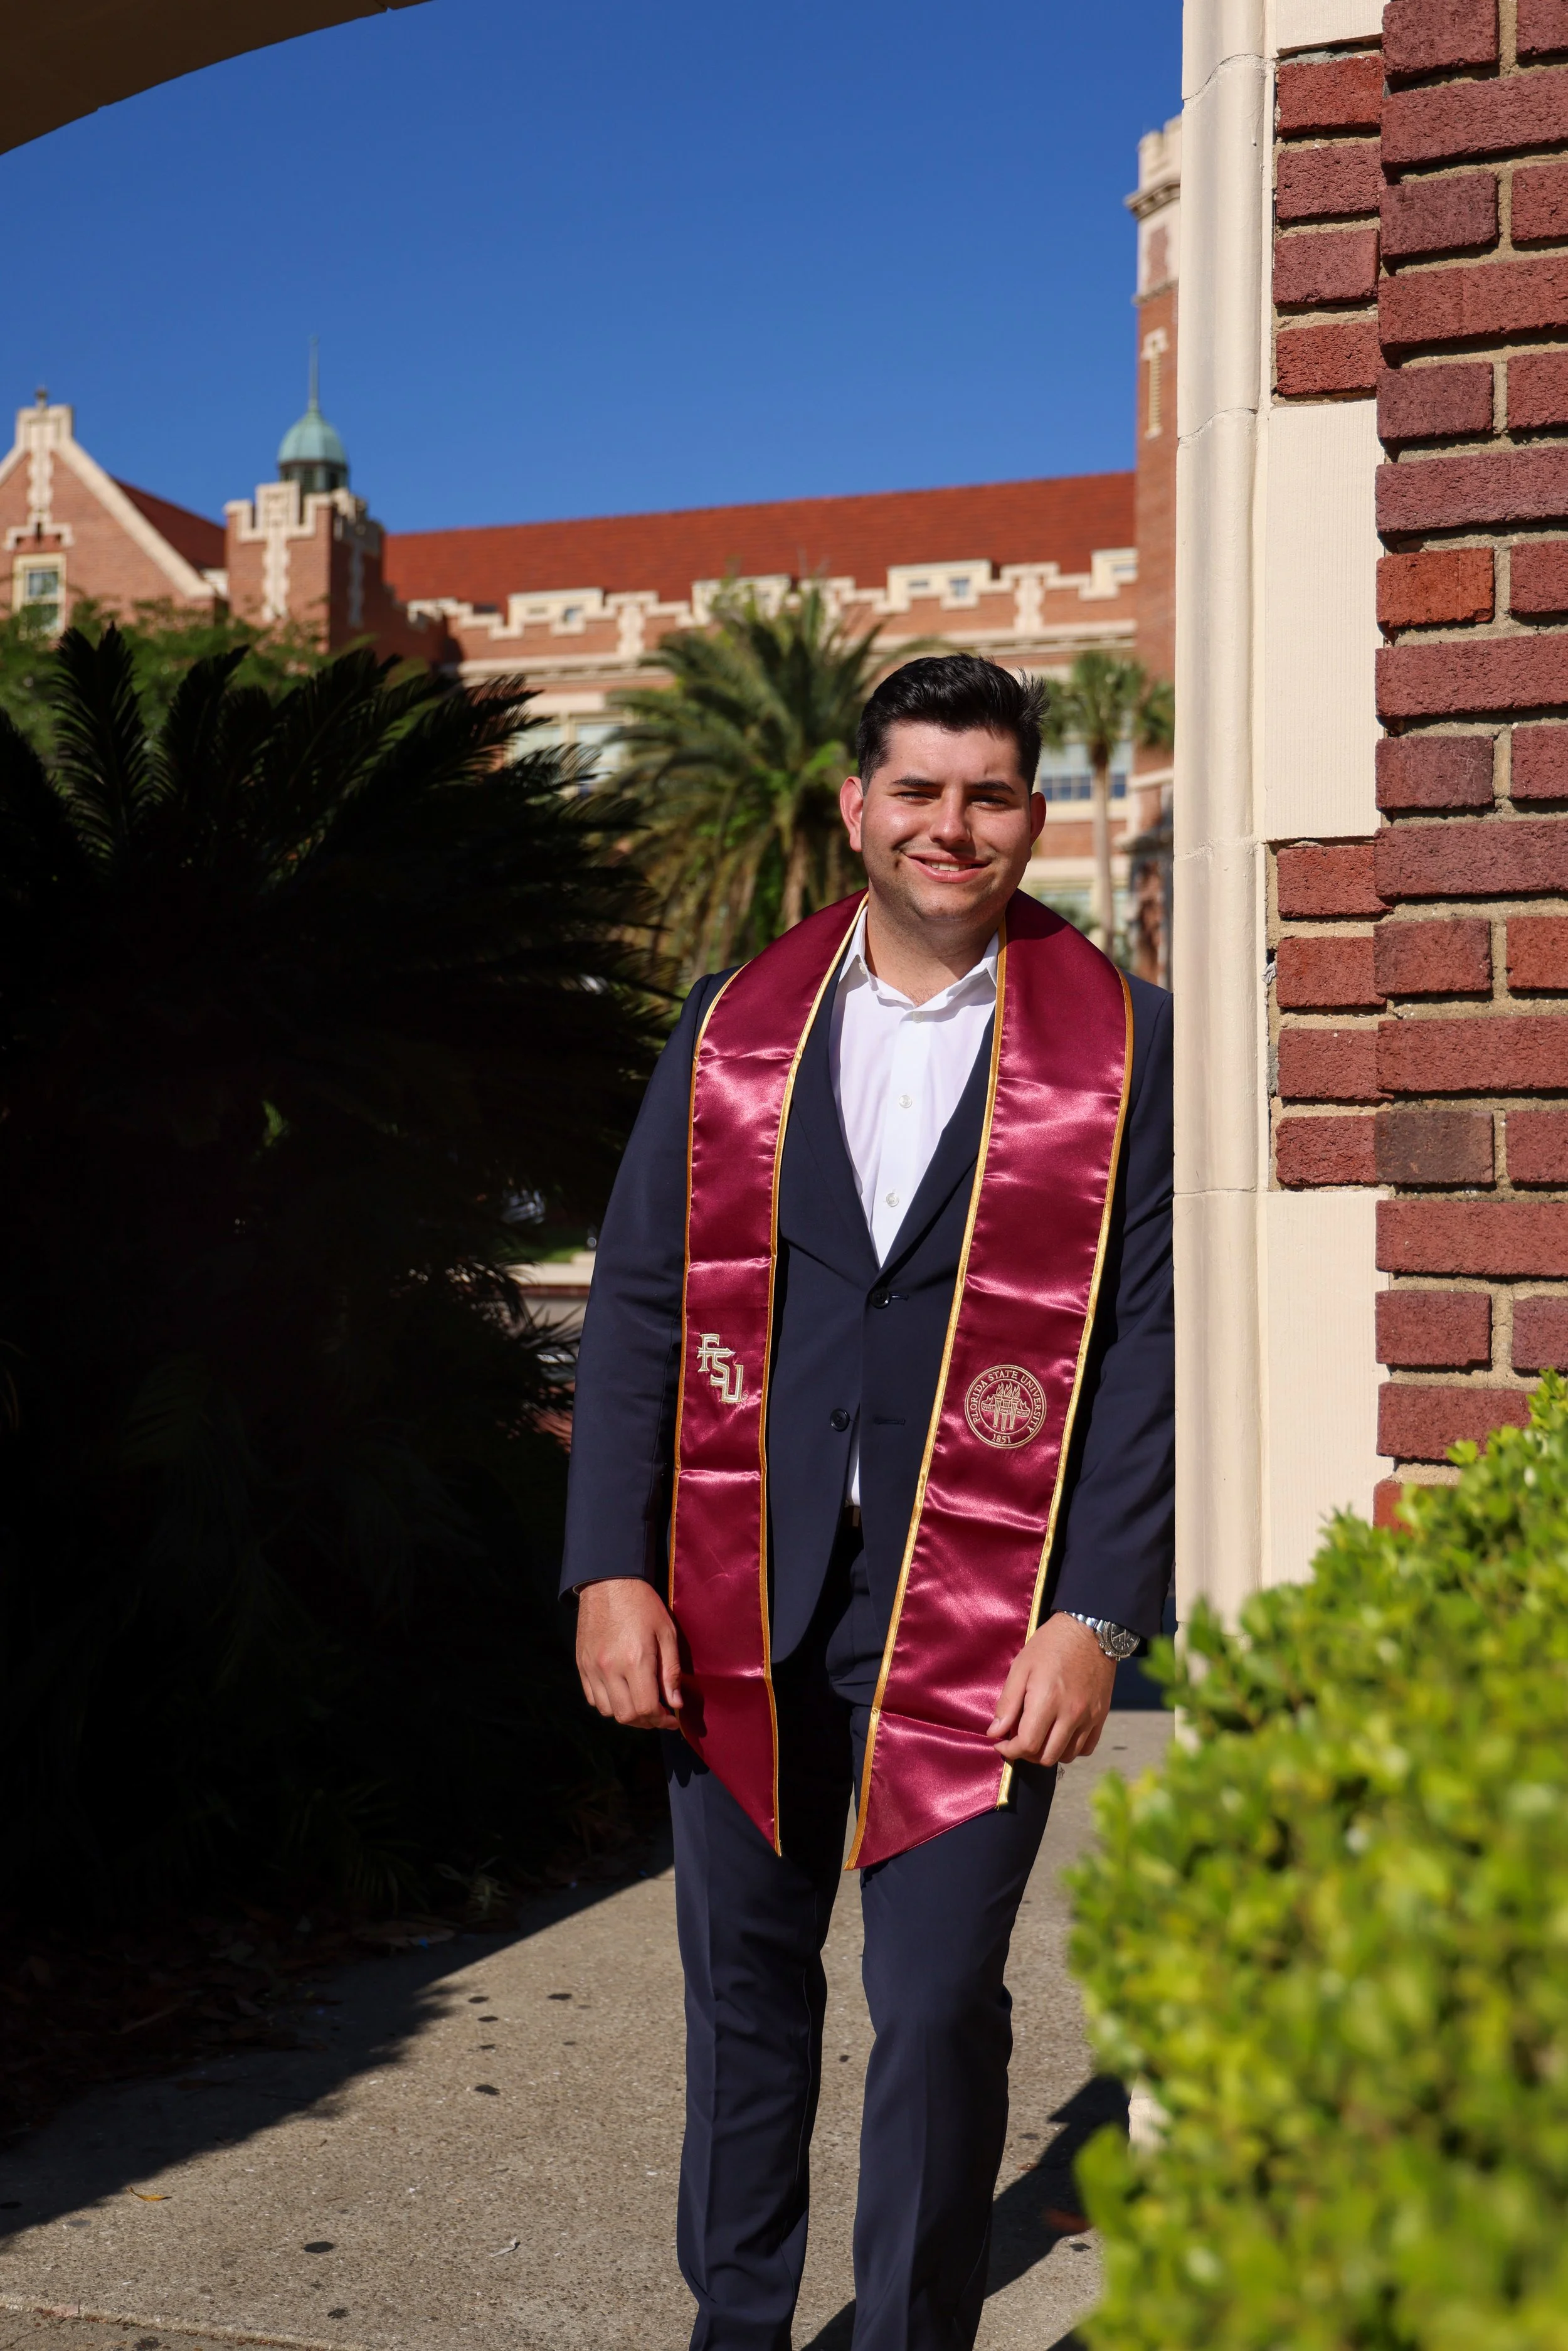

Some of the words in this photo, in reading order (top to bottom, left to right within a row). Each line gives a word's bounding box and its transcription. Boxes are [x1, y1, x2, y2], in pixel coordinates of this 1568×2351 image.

[697, 1333, 743, 1403] FSU
[970, 1380, 988, 1423] FLORIDA
[988, 1370, 1019, 1381] STATE
[1020, 1376, 1041, 1433] UNIVERSITY
[991, 1433, 1012, 1443] 1851
